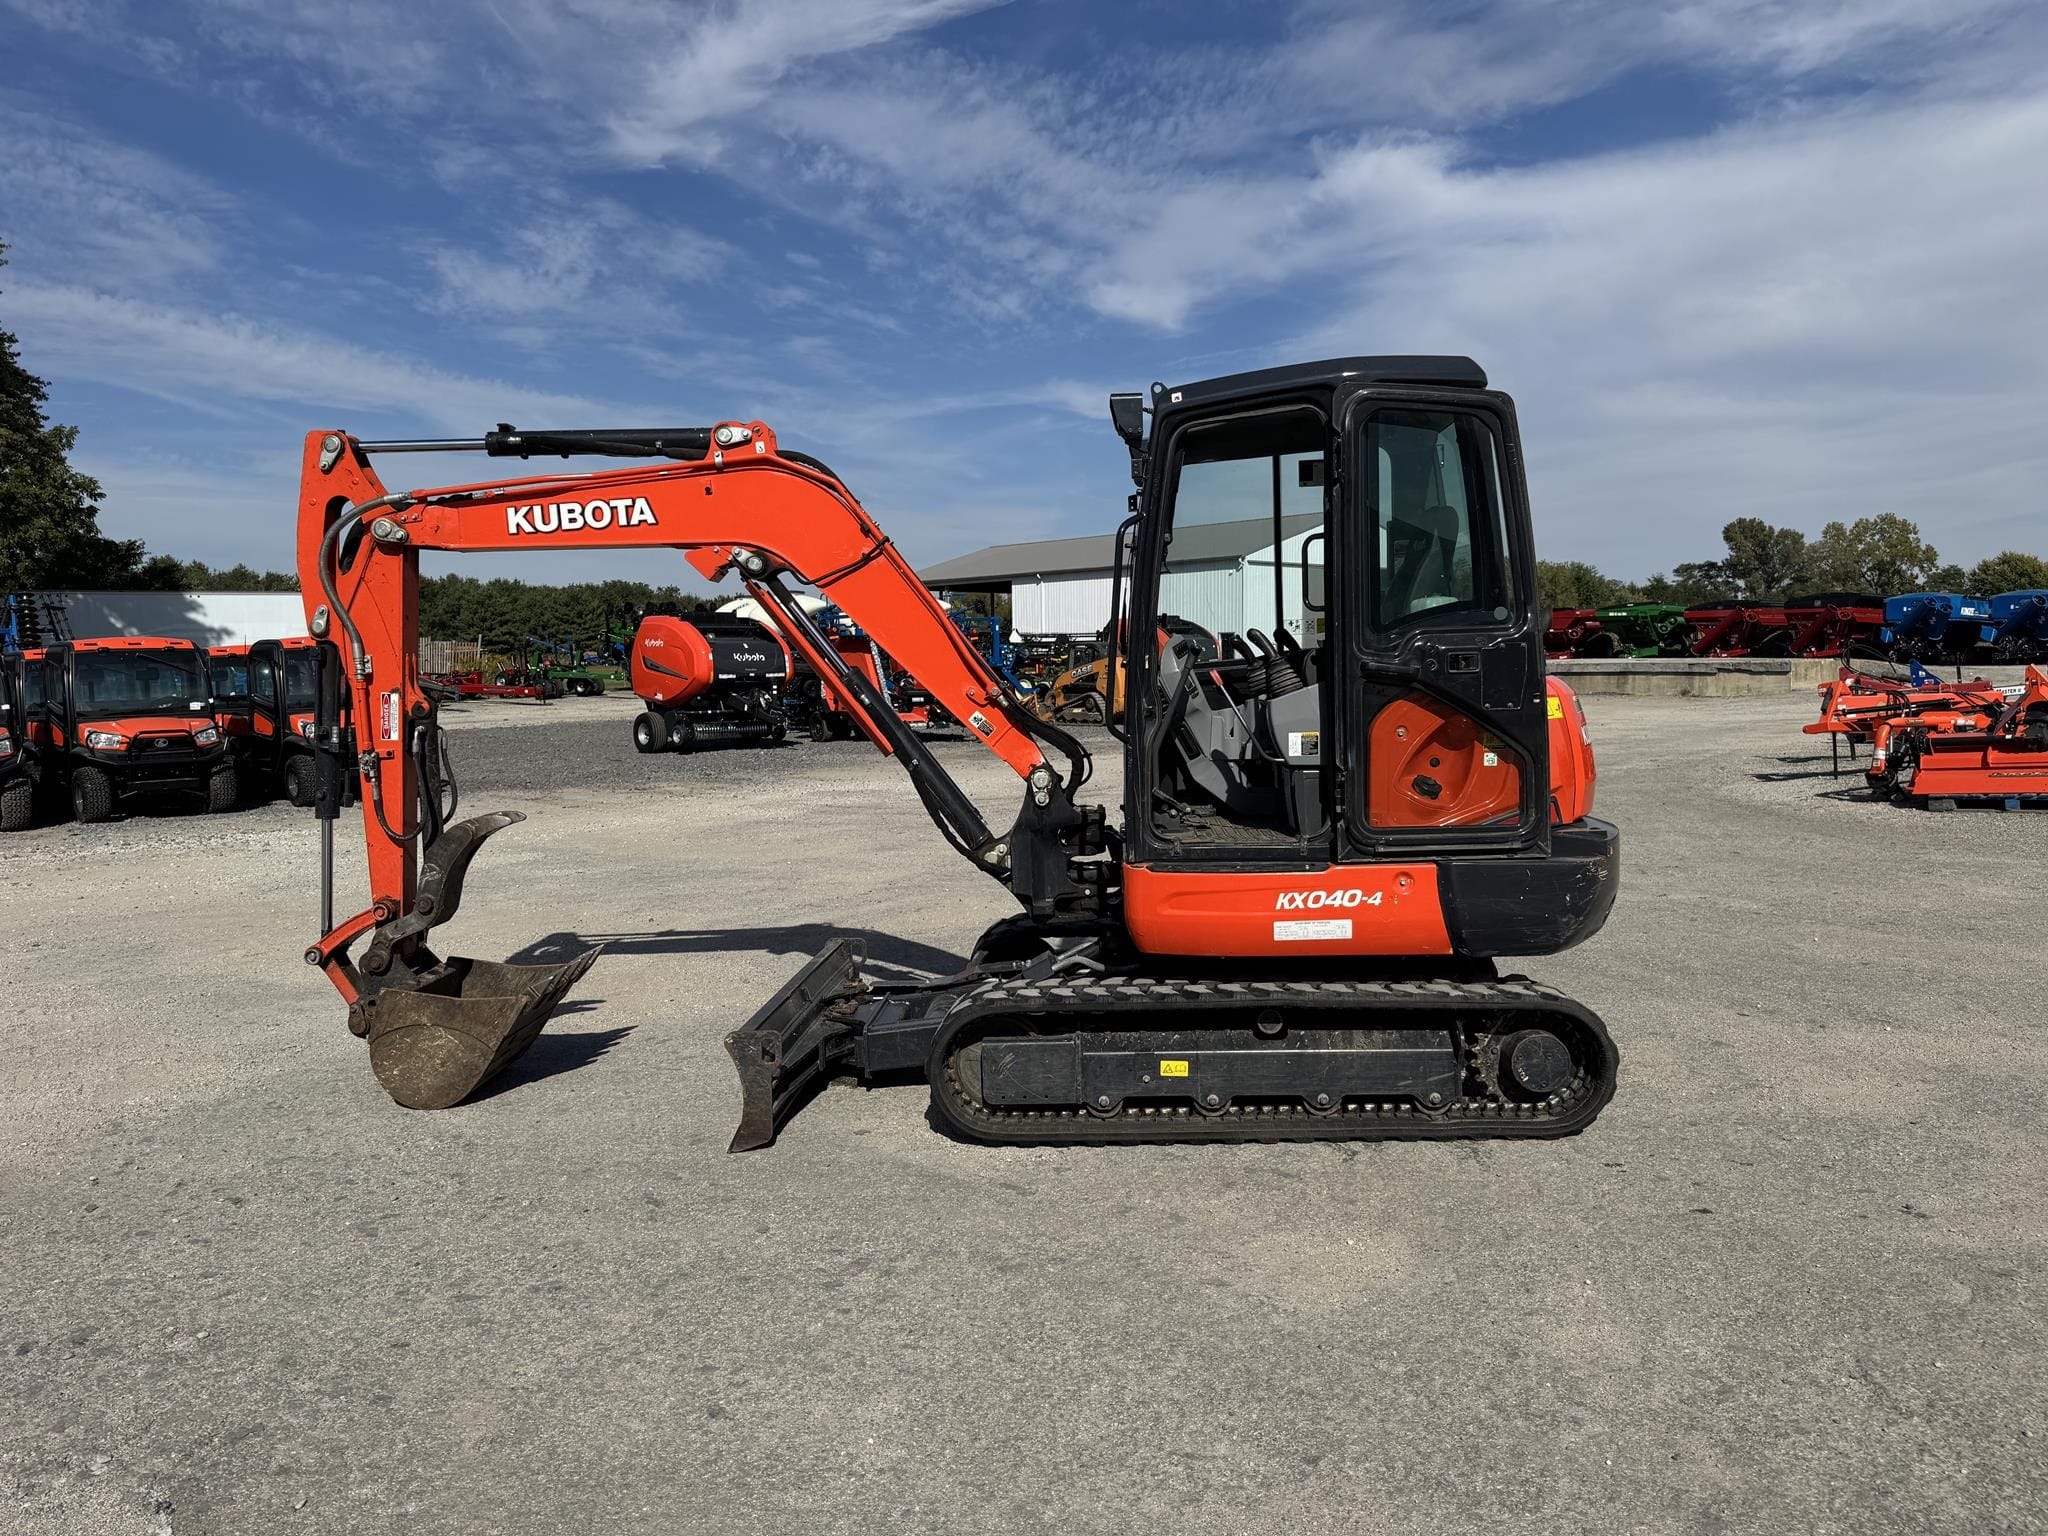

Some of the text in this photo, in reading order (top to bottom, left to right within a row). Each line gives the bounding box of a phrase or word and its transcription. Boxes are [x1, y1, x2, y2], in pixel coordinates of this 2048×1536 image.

[506, 497, 657, 535] KUBOTA
[645, 638, 664, 647] Kubota
[733, 652, 766, 662] Kubota
[1071, 664, 1092, 678] CASE
[1275, 889, 1383, 910] KX040-4
